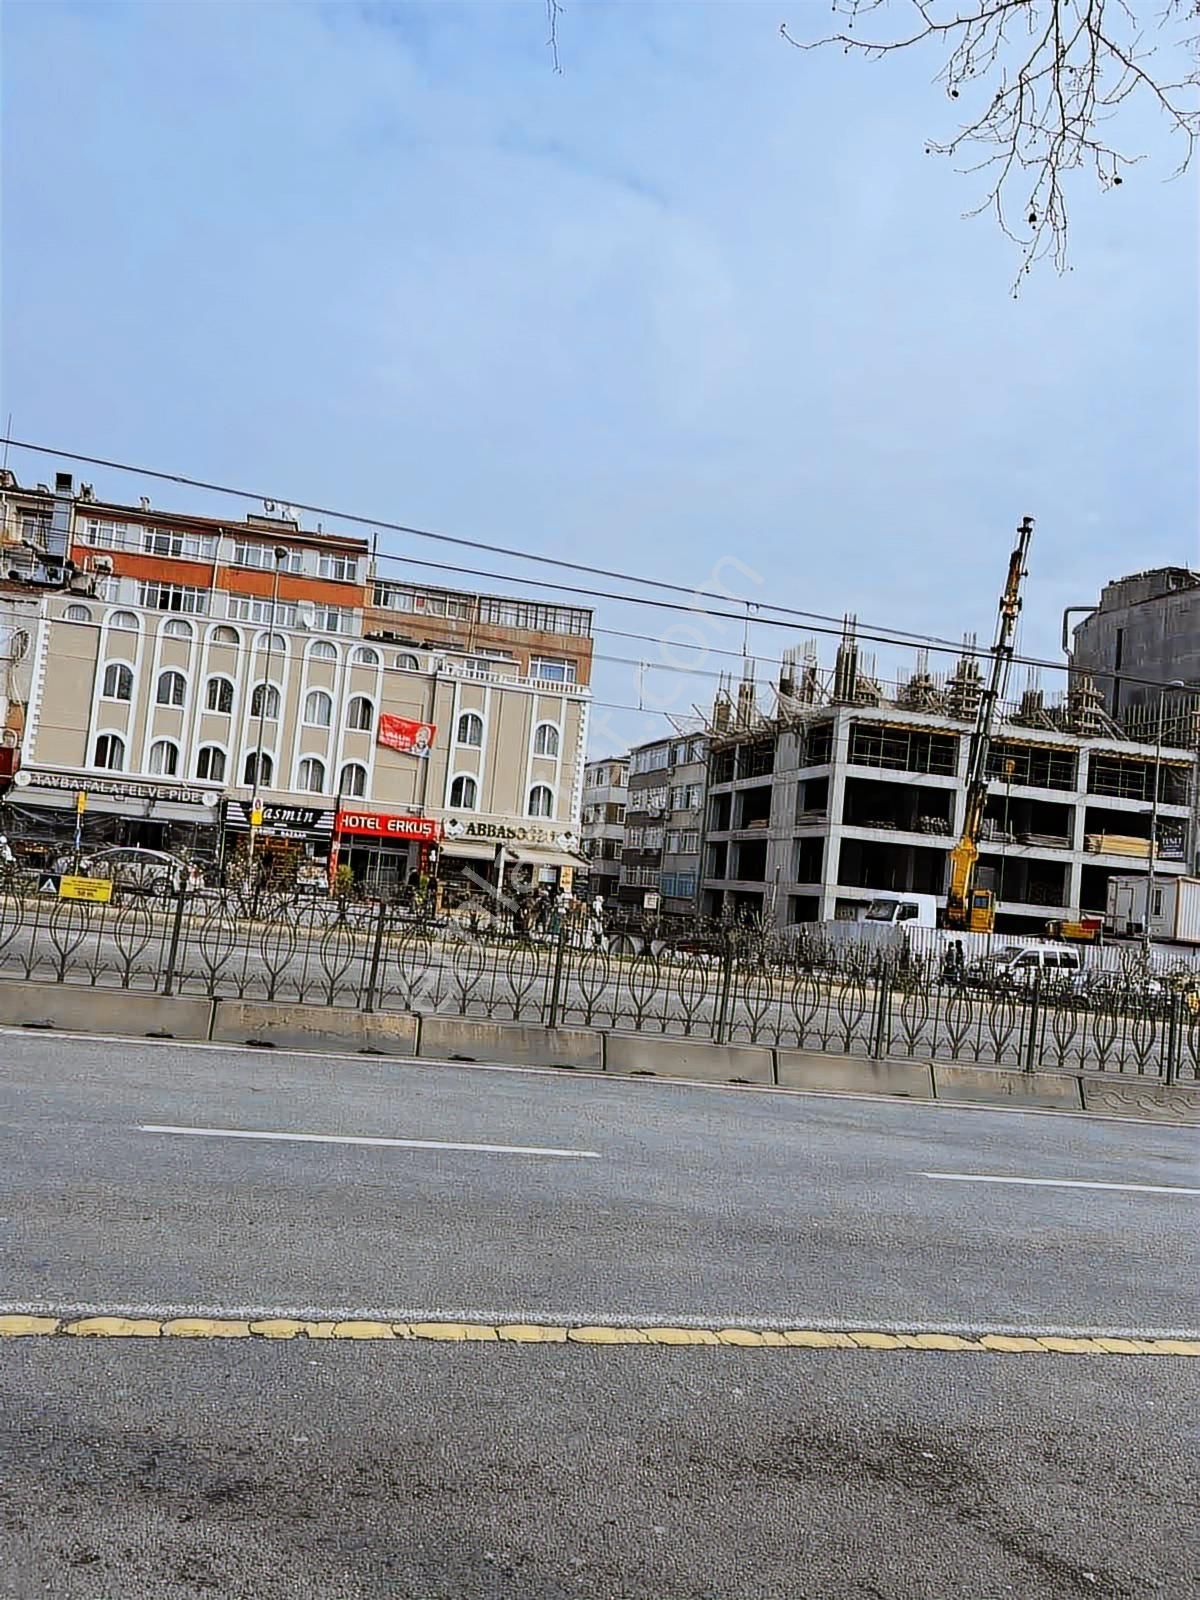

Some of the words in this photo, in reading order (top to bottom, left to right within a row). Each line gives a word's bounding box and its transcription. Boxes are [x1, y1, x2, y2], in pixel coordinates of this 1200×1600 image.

[83, 780, 145, 797] FALAFEL
[148, 786, 165, 799] VE
[249, 806, 314, 823] asmin
[342, 815, 382, 830] HOTEL
[387, 819, 432, 837] ERKUŞ
